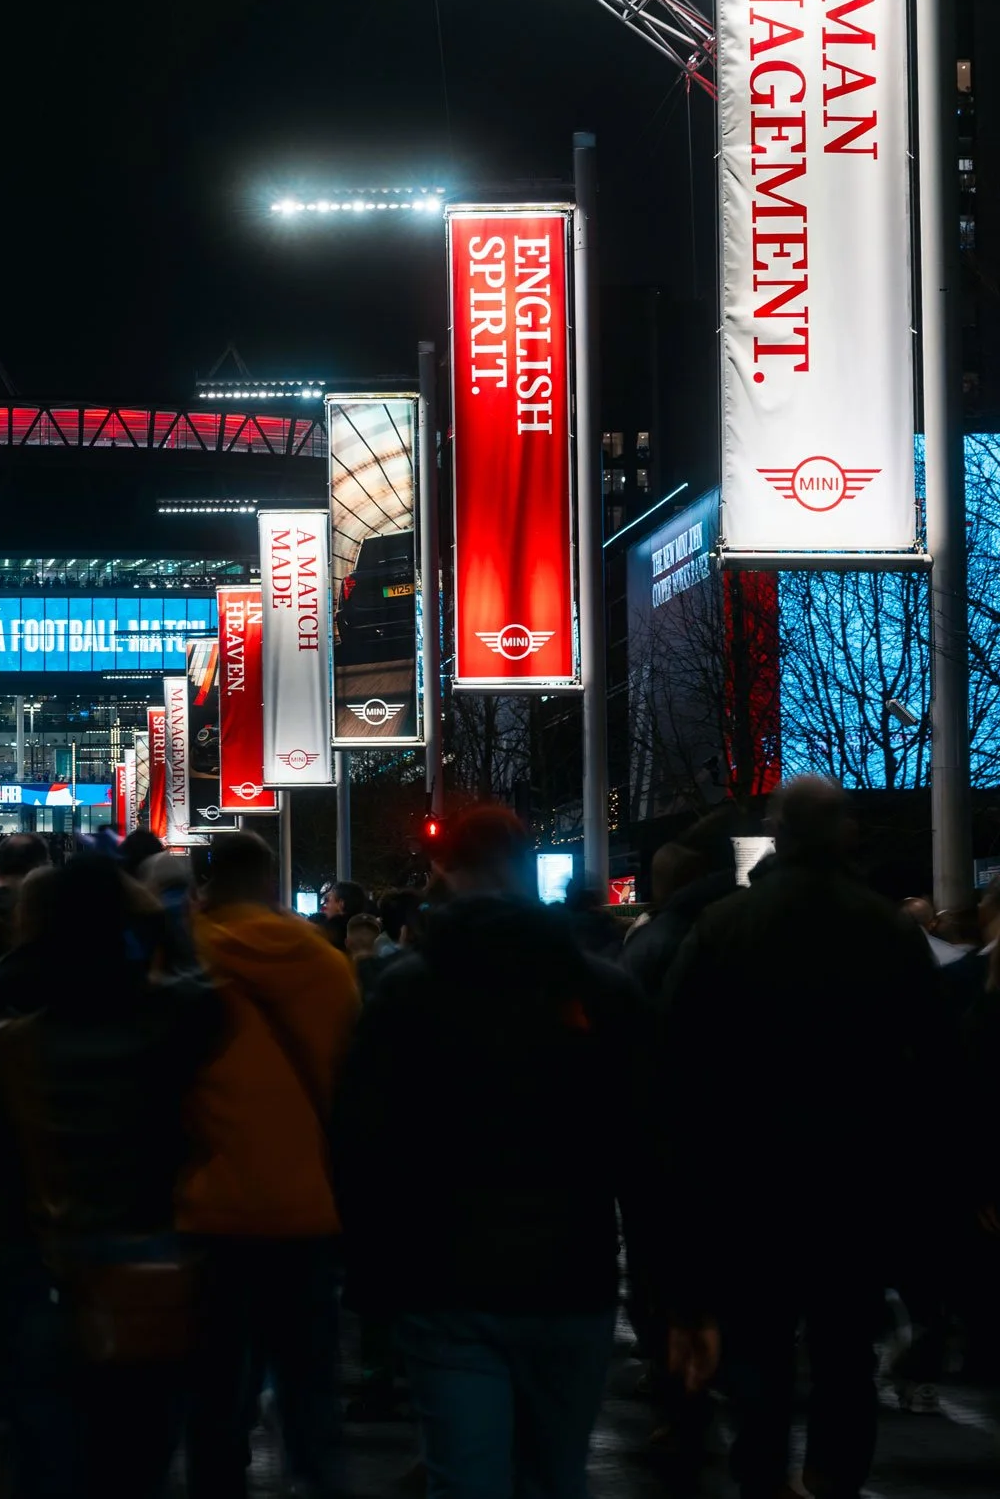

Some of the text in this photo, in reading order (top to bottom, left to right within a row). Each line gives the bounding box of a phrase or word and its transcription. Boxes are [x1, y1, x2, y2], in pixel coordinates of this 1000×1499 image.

[467, 235, 508, 397] SPIRIT.
[513, 234, 554, 436] ENGLISH
[799, 477, 840, 491] MINI
[271, 529, 292, 610] MADE
[296, 527, 319, 651] A MATCH
[9, 618, 124, 653] FOOTBALL
[226, 601, 245, 697] HEAVEN.
[247, 601, 263, 624] IN
[501, 636, 529, 648] MINI
[171, 688, 185, 808] MANAGEMENT.
[366, 708, 385, 716] MINI
